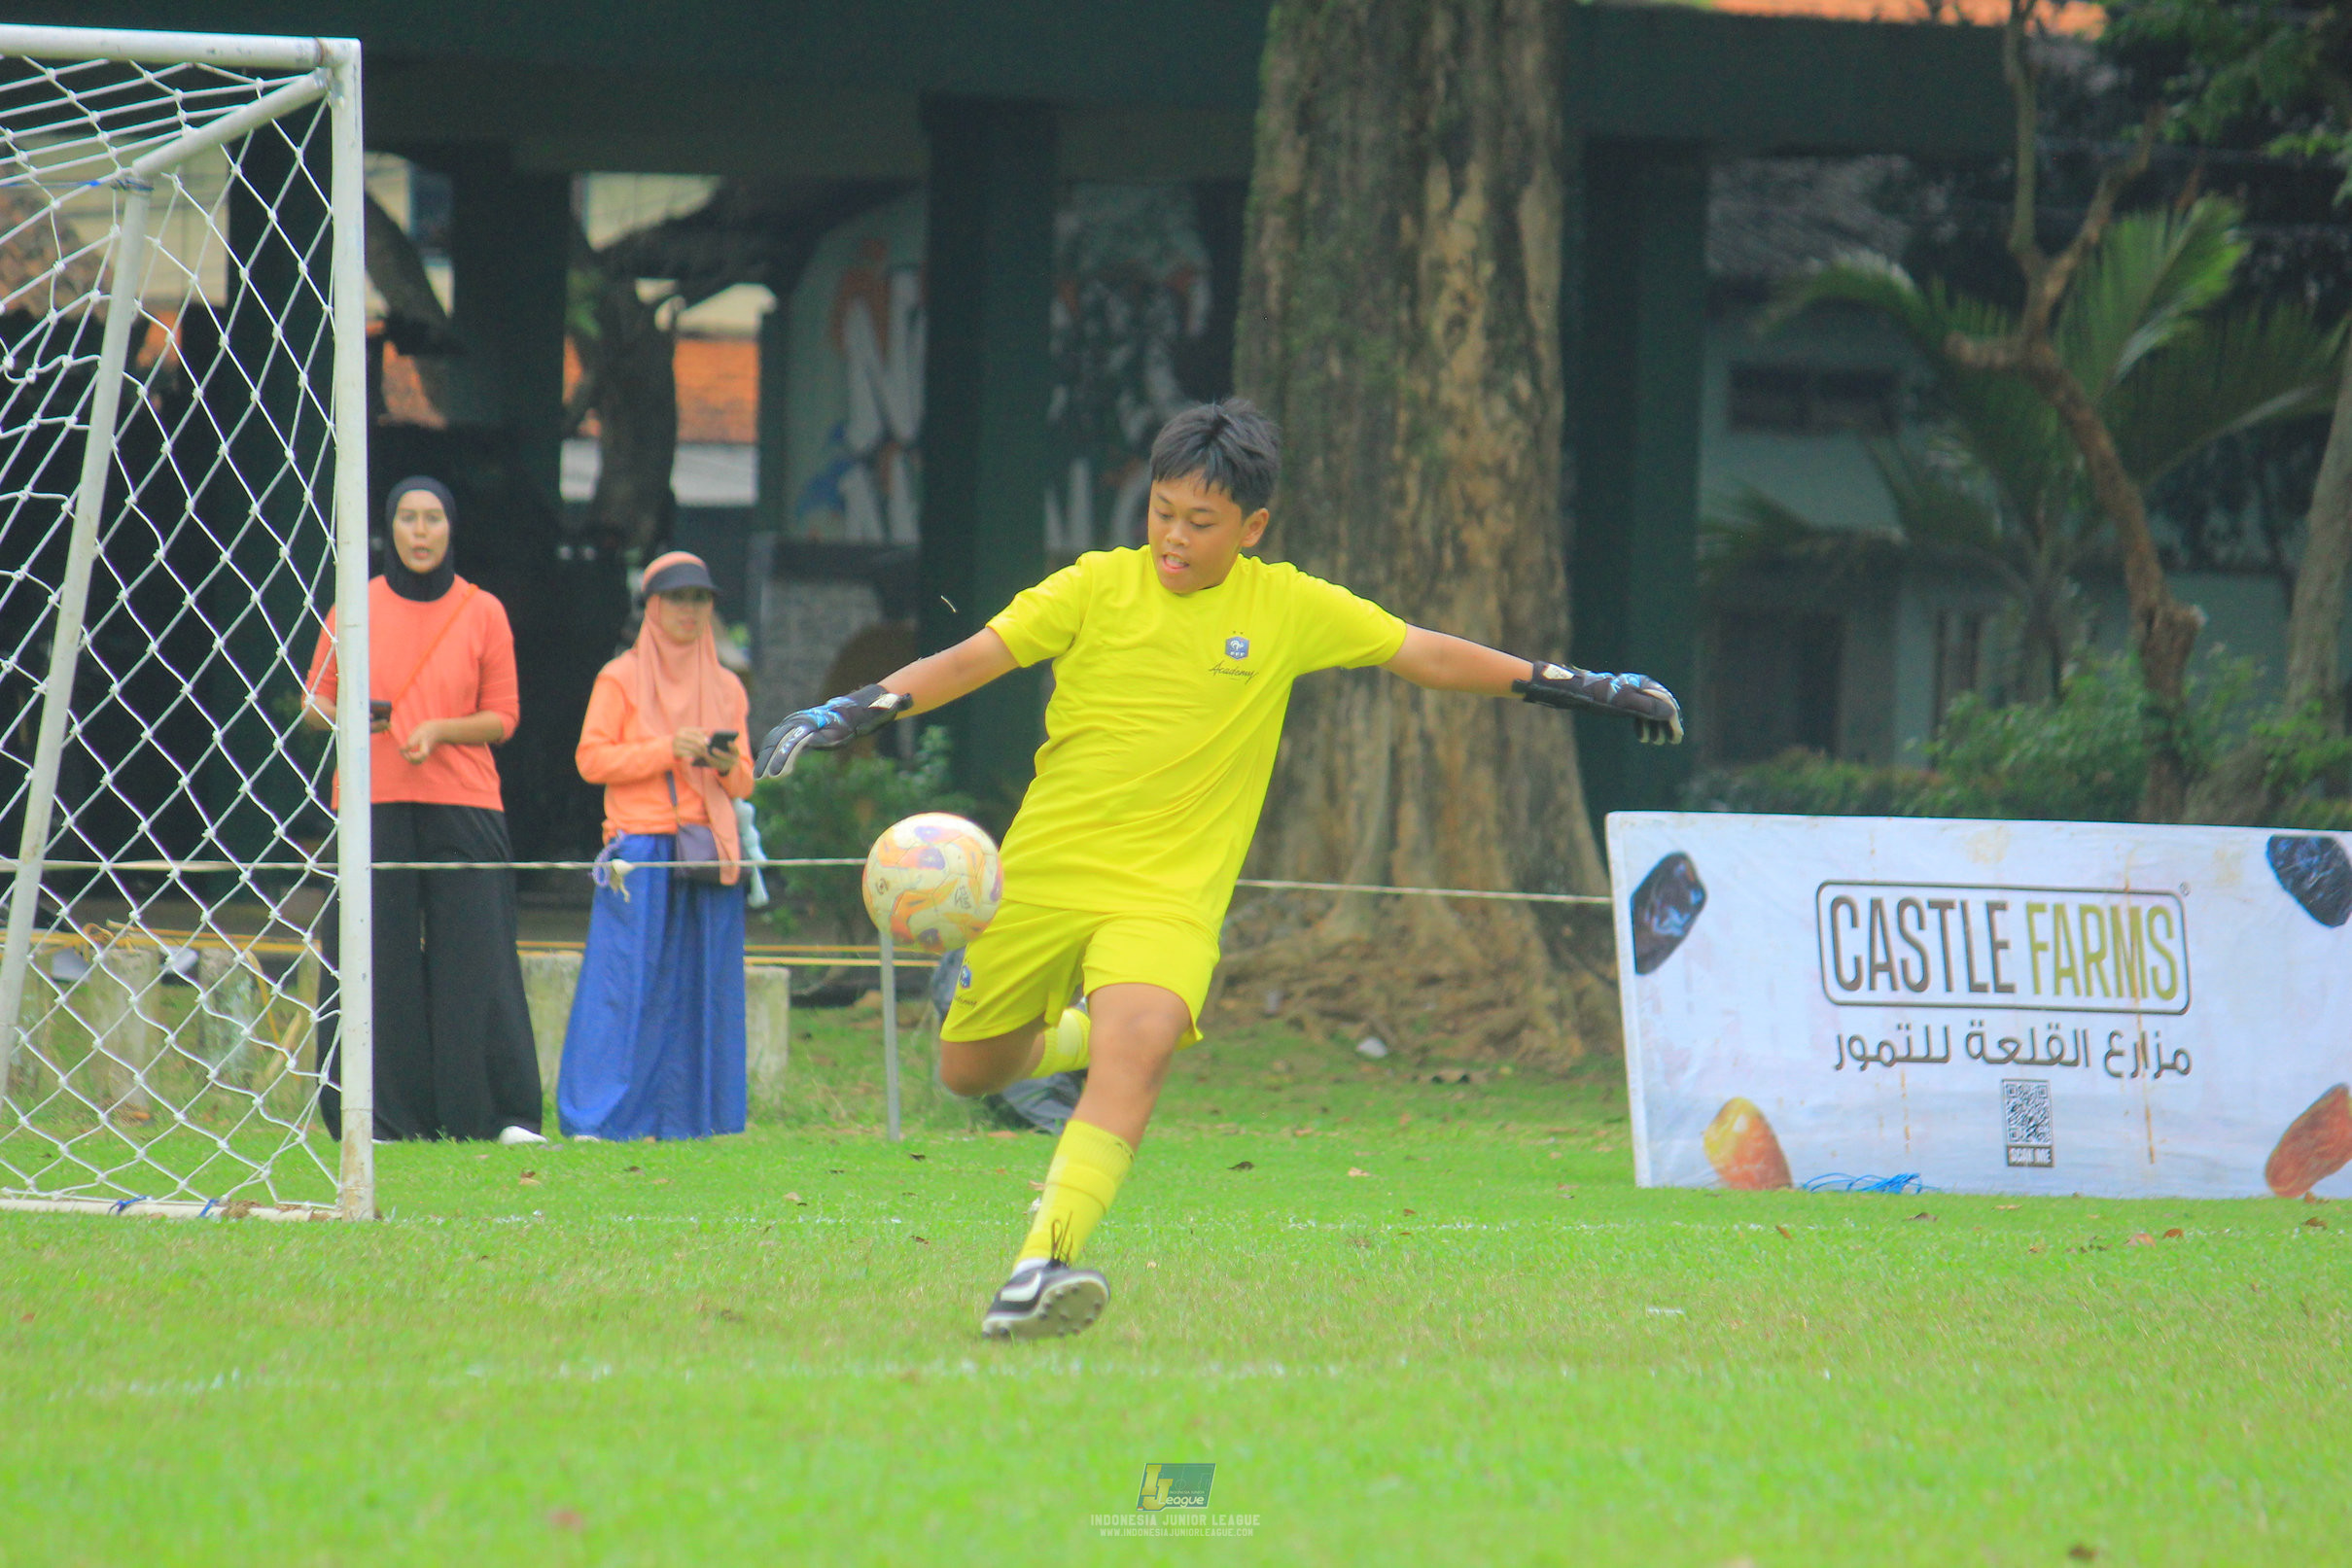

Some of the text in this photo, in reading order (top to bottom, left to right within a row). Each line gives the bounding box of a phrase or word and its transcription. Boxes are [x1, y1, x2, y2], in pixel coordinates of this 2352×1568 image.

[1209, 660, 1259, 684] Academy
[1830, 894, 2179, 1001] CASTLE FARMS
[1834, 1019, 2193, 1079] مزارع القلعة للتمور
